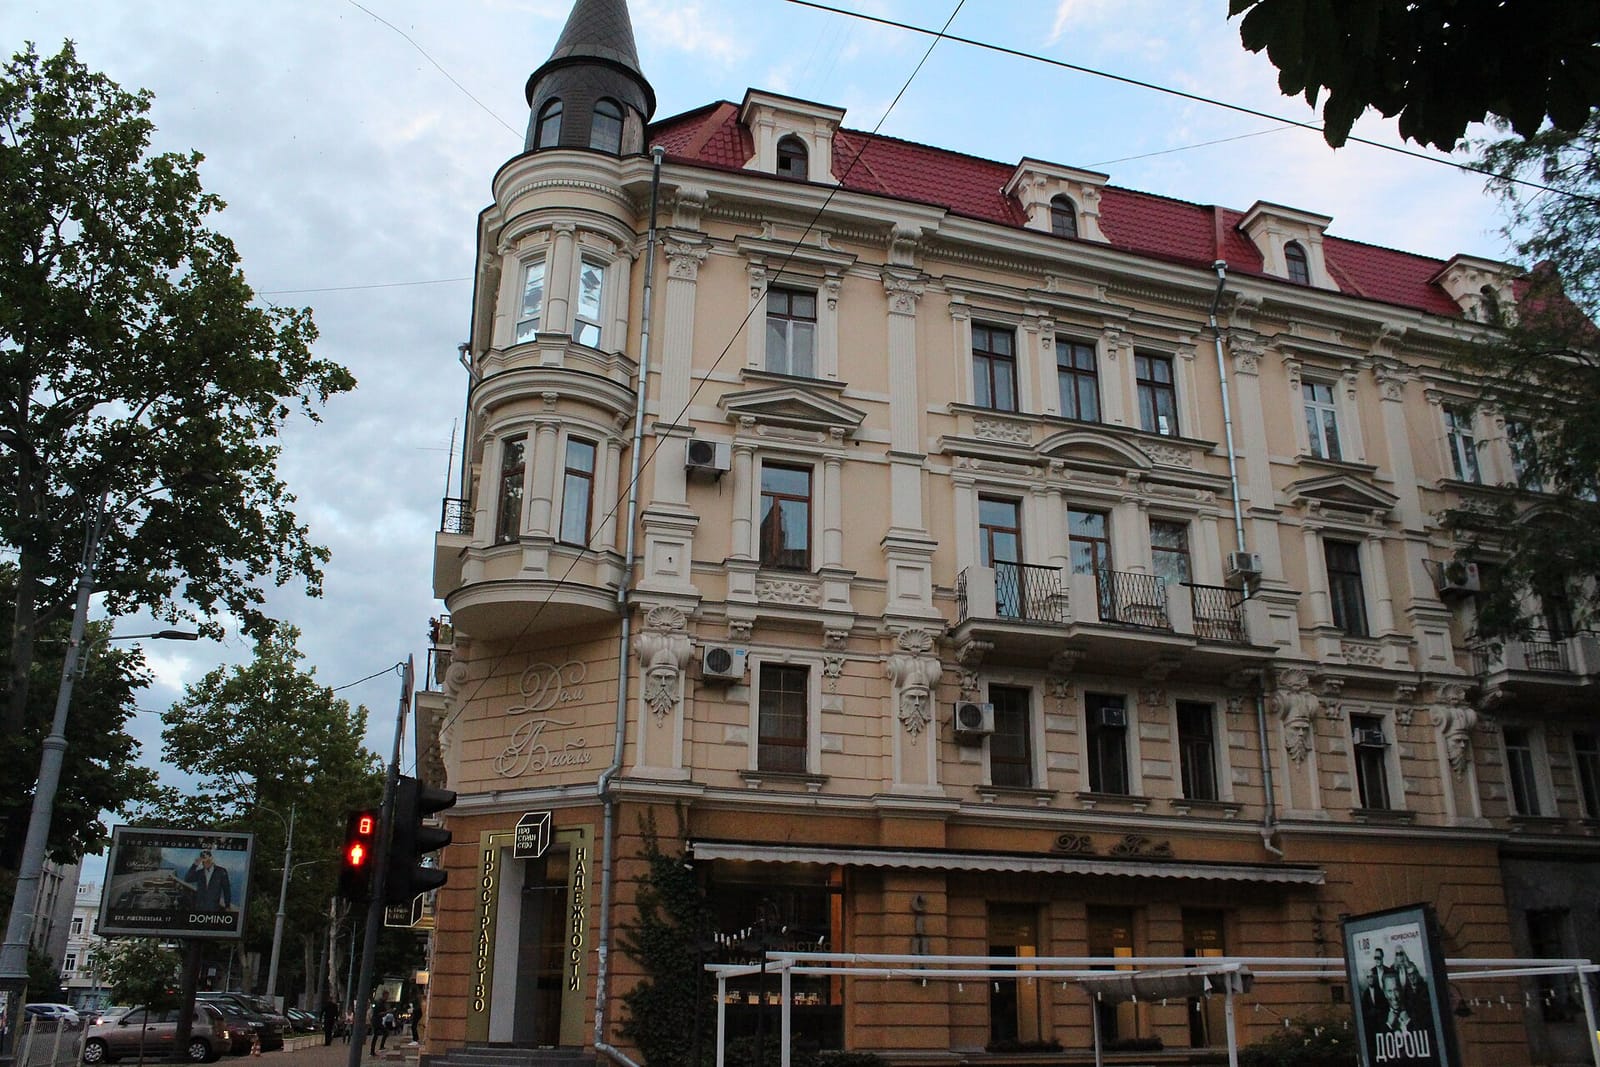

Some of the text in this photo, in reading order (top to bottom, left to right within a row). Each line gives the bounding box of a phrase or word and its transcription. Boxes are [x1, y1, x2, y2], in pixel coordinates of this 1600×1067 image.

[507, 660, 586, 715] Дом
[494, 717, 592, 778] Бабеля
[359, 818, 372, 835] 8
[188, 913, 233, 925] DOMINO
[473, 848, 496, 1013] ПРОСТРАНСТВО
[568, 847, 588, 991] НАДЕЖНОСТИ
[1375, 1029, 1431, 1063] ДОРОШ
